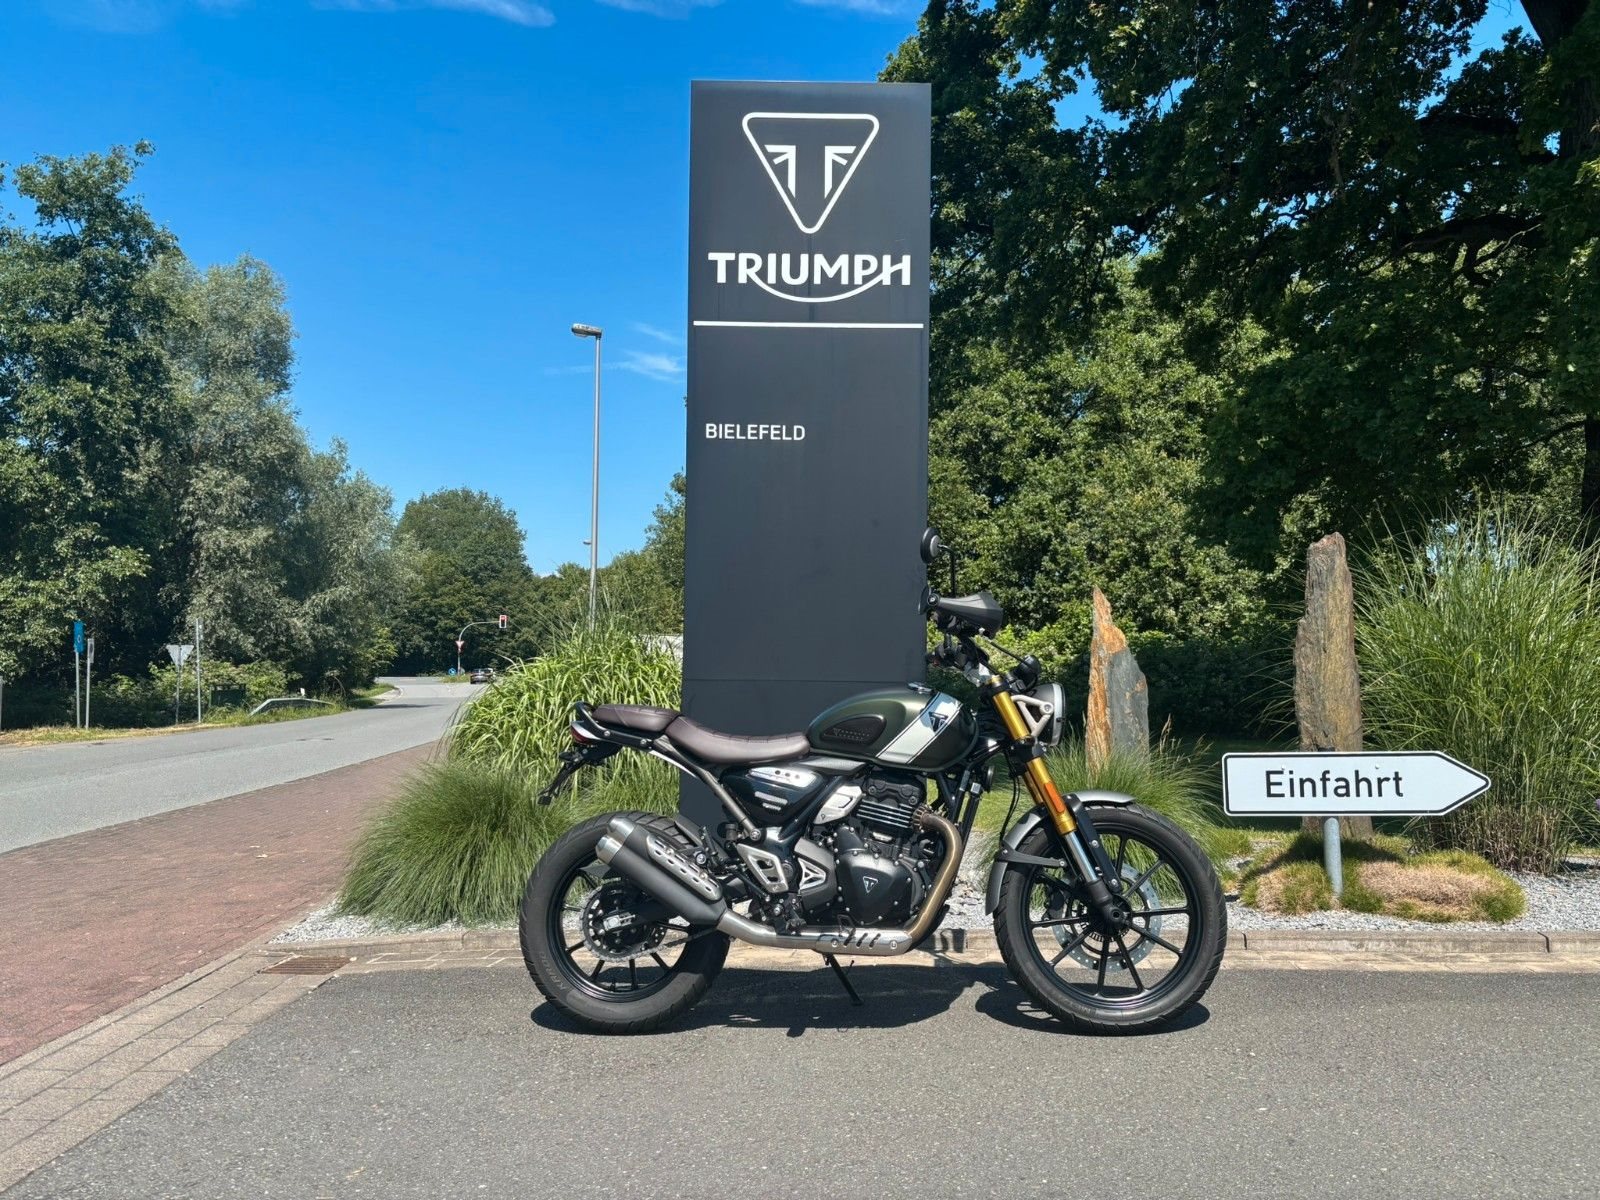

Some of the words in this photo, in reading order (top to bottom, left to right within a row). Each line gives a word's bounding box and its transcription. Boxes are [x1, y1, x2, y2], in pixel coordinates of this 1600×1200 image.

[708, 252, 911, 303] TRIUMPH
[705, 423, 806, 441] BIELEFELD
[1265, 768, 1404, 798] Einfahrt
